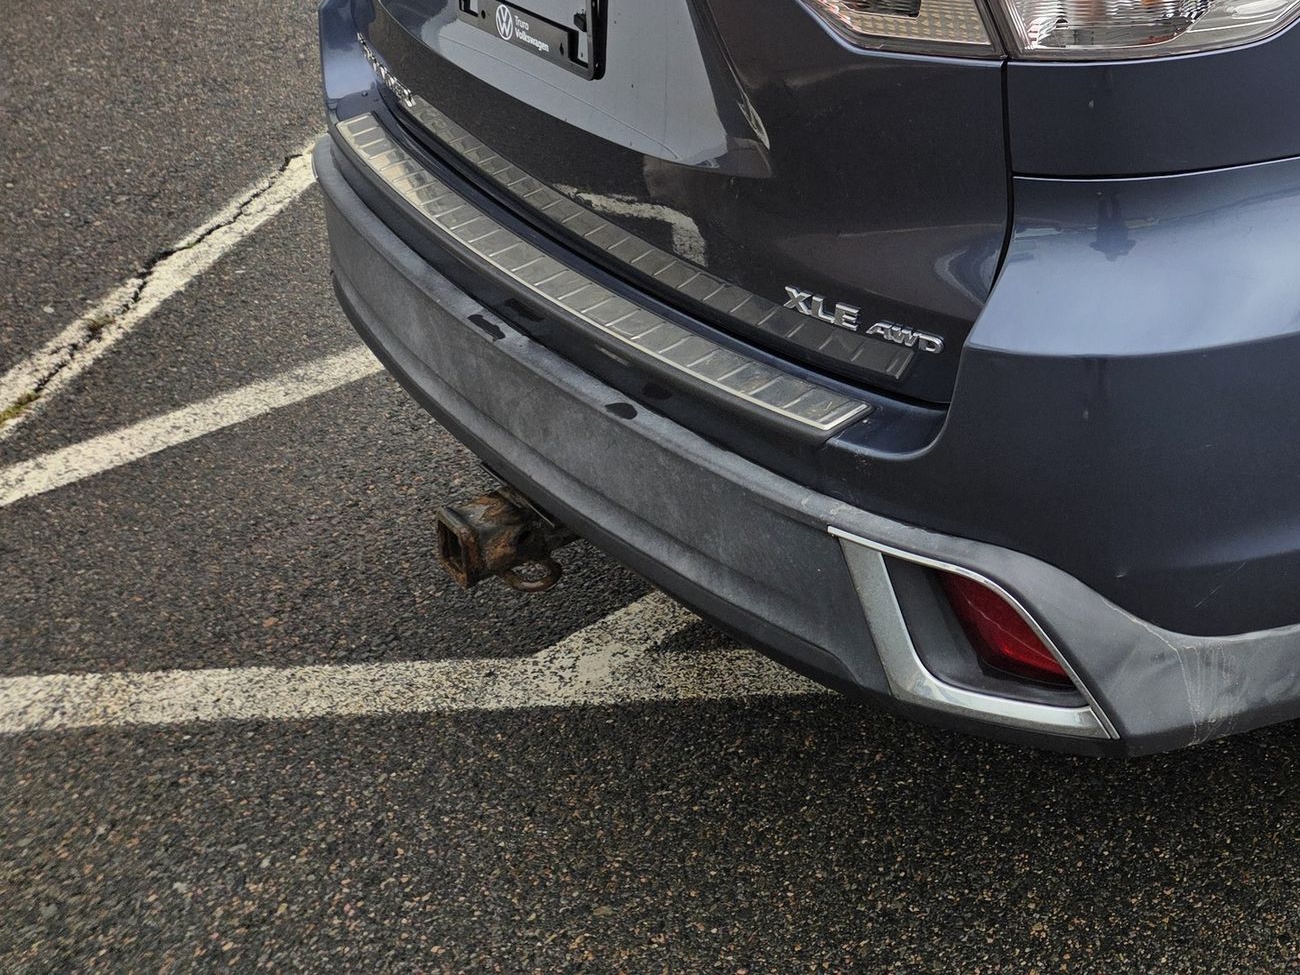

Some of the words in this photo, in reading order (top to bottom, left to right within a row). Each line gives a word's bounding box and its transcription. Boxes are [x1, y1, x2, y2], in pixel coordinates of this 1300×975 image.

[515, 15, 529, 31] Truro
[515, 27, 549, 52] Volkswagen
[783, 285, 861, 332] XLE
[866, 320, 945, 354] AWD
